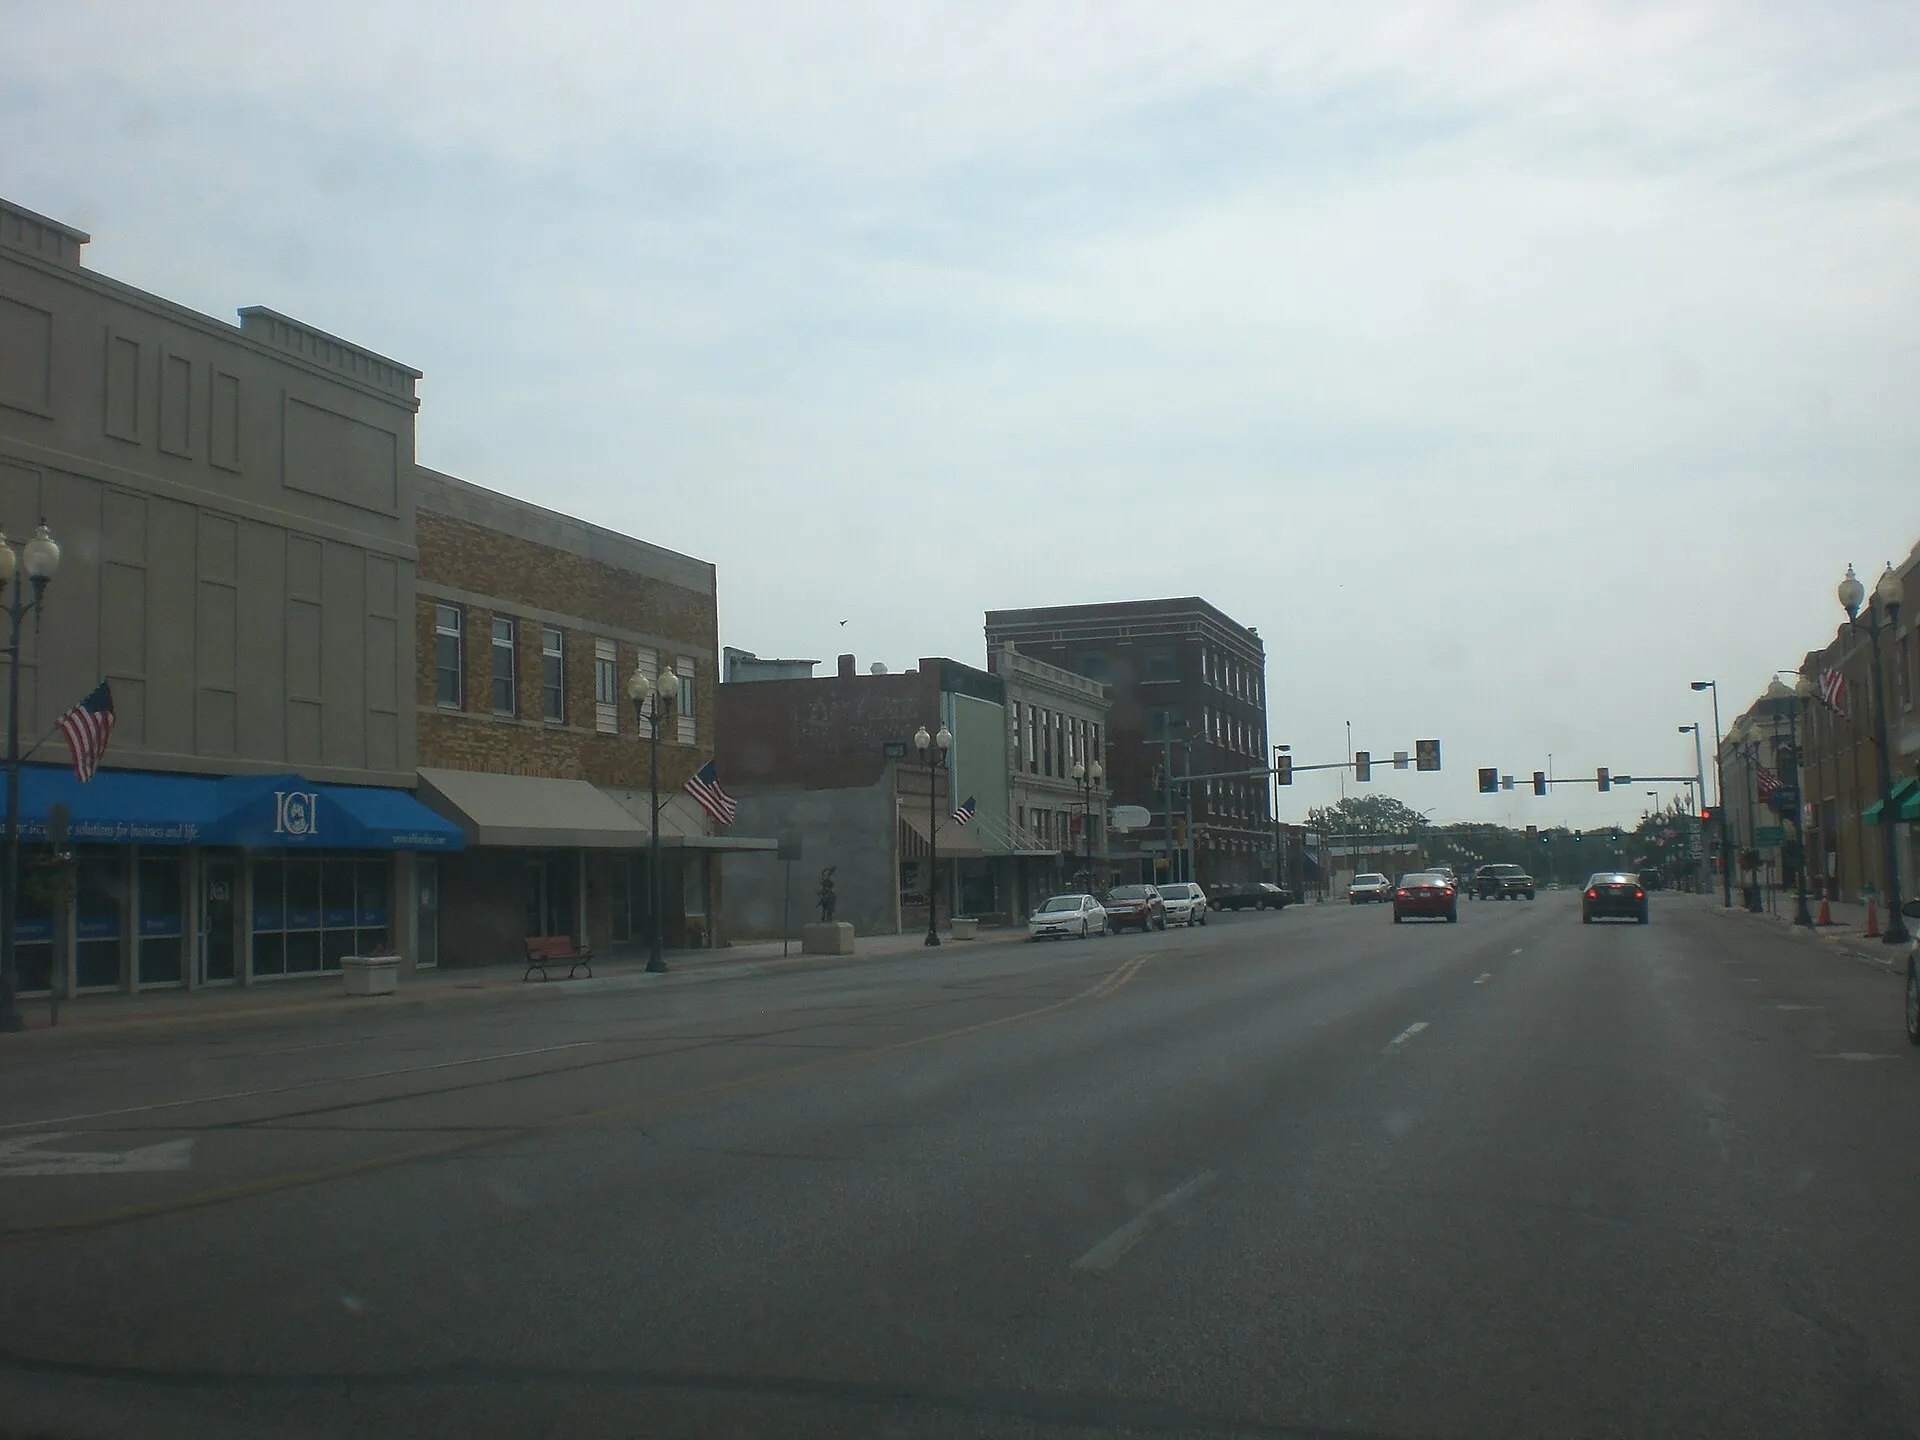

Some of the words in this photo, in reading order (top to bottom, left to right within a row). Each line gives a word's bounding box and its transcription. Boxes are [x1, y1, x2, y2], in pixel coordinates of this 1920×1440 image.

[273, 791, 319, 835] ICI
[113, 821, 129, 841] for
[130, 822, 164, 839] business
[165, 823, 182, 839] and
